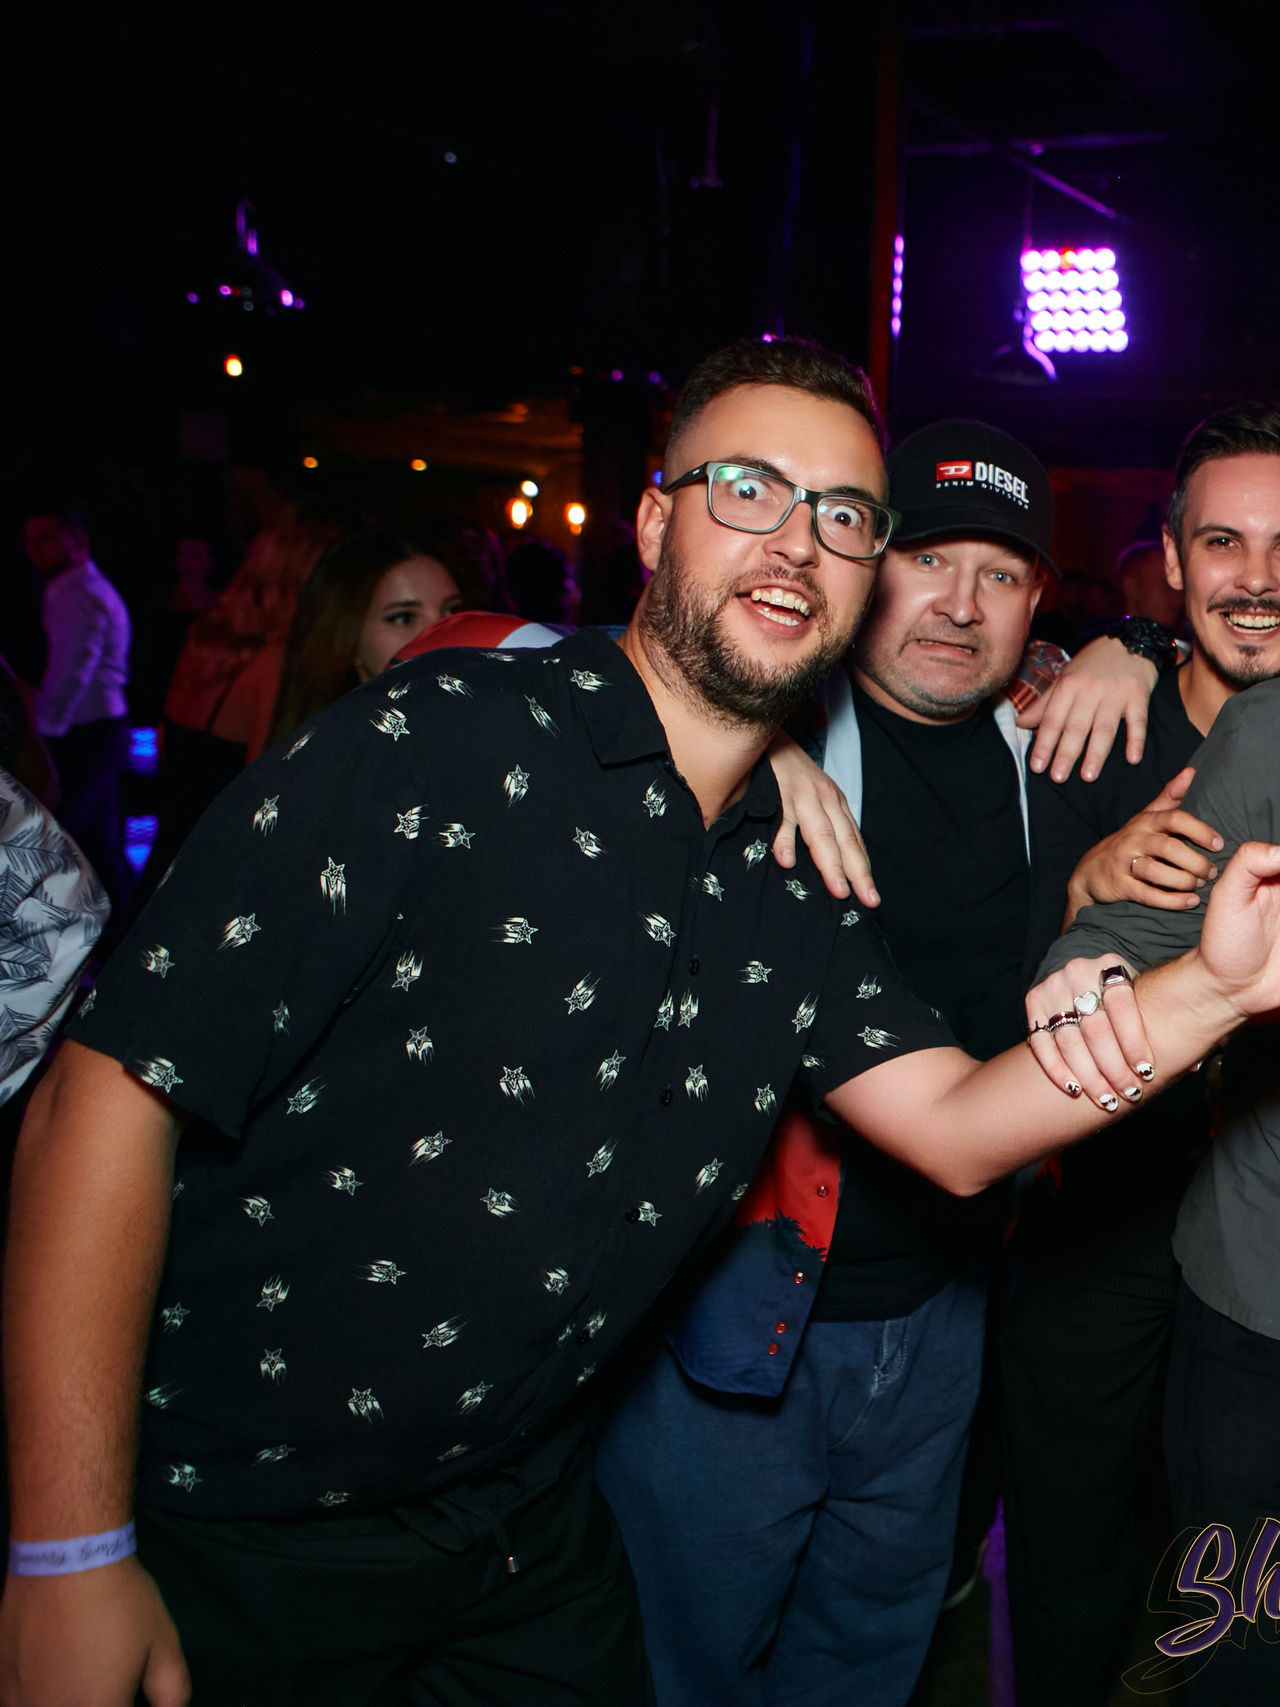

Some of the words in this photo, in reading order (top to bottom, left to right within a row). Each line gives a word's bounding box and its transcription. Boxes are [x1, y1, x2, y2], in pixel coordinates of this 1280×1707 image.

[936, 480, 974, 489] DENIM
[982, 482, 1029, 510] DIVISION
[975, 461, 1029, 504] DIESEL
